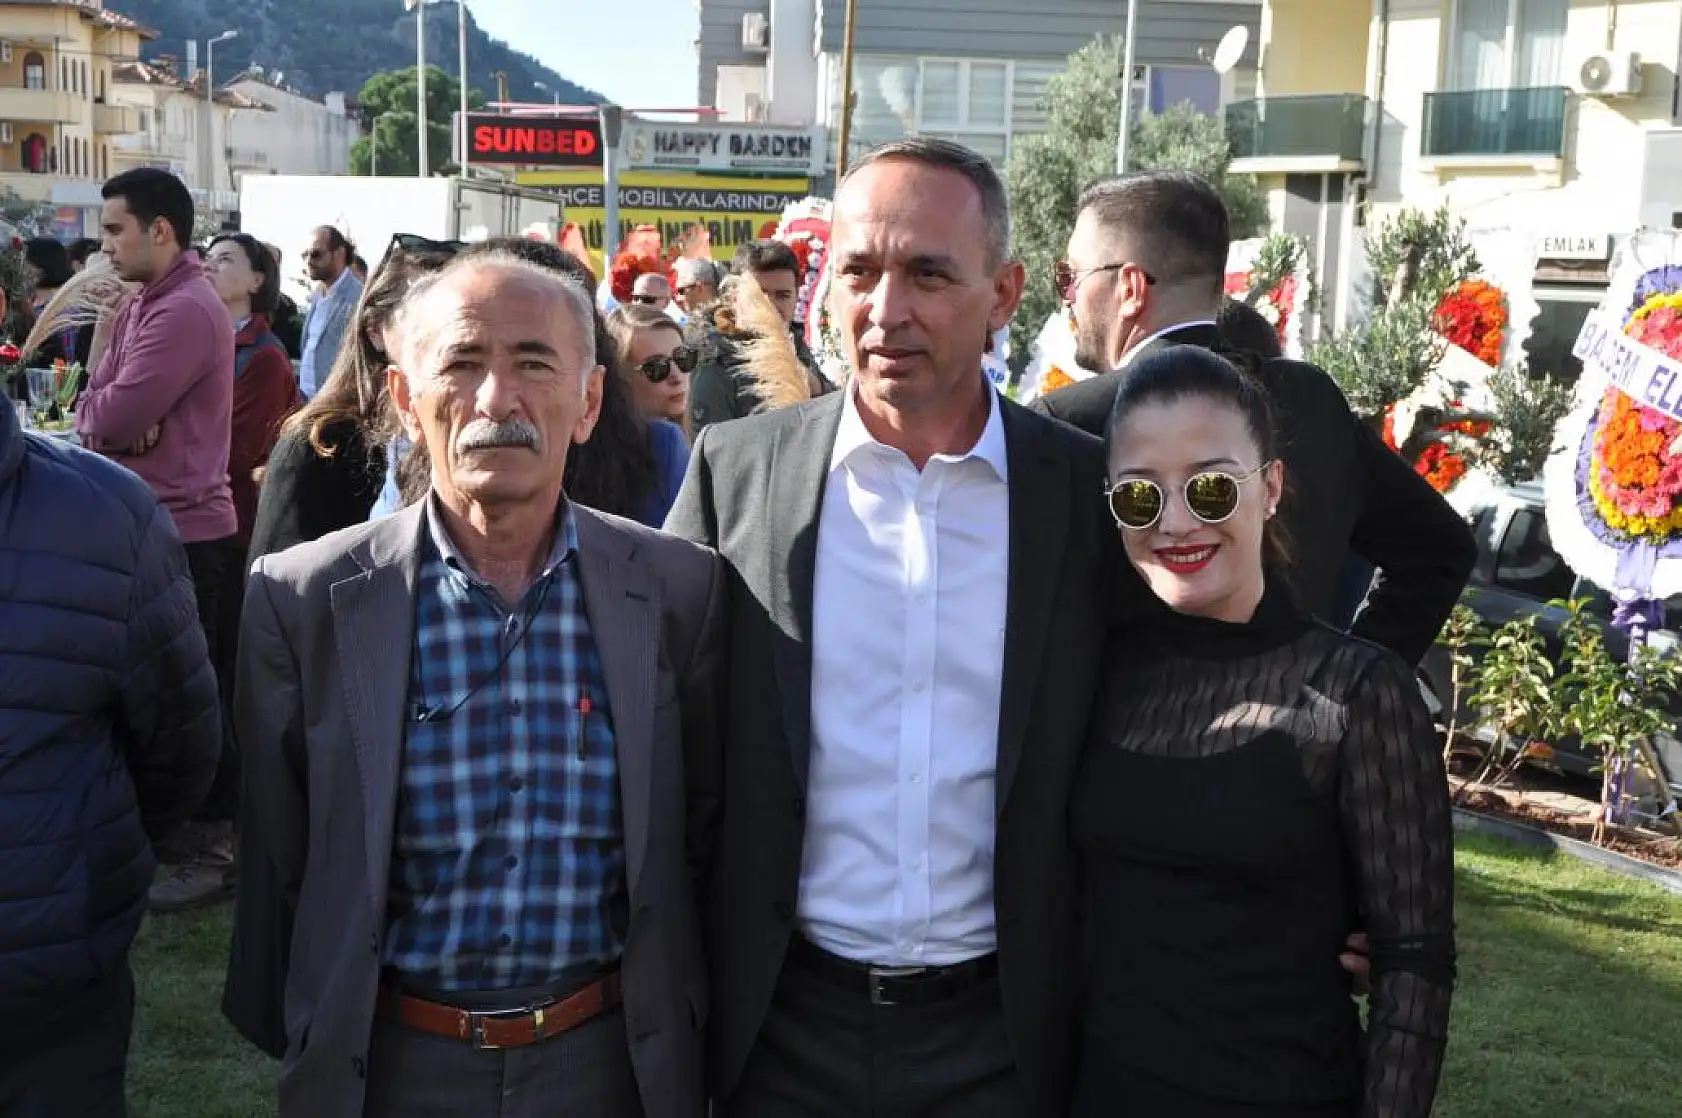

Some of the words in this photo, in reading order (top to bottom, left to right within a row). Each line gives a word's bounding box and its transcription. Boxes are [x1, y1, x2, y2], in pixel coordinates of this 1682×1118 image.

[473, 126, 596, 155] SUNBED
[654, 130, 720, 155] HAPPY
[547, 187, 601, 207] HÇE
[1544, 236, 1597, 252] EMLAK
